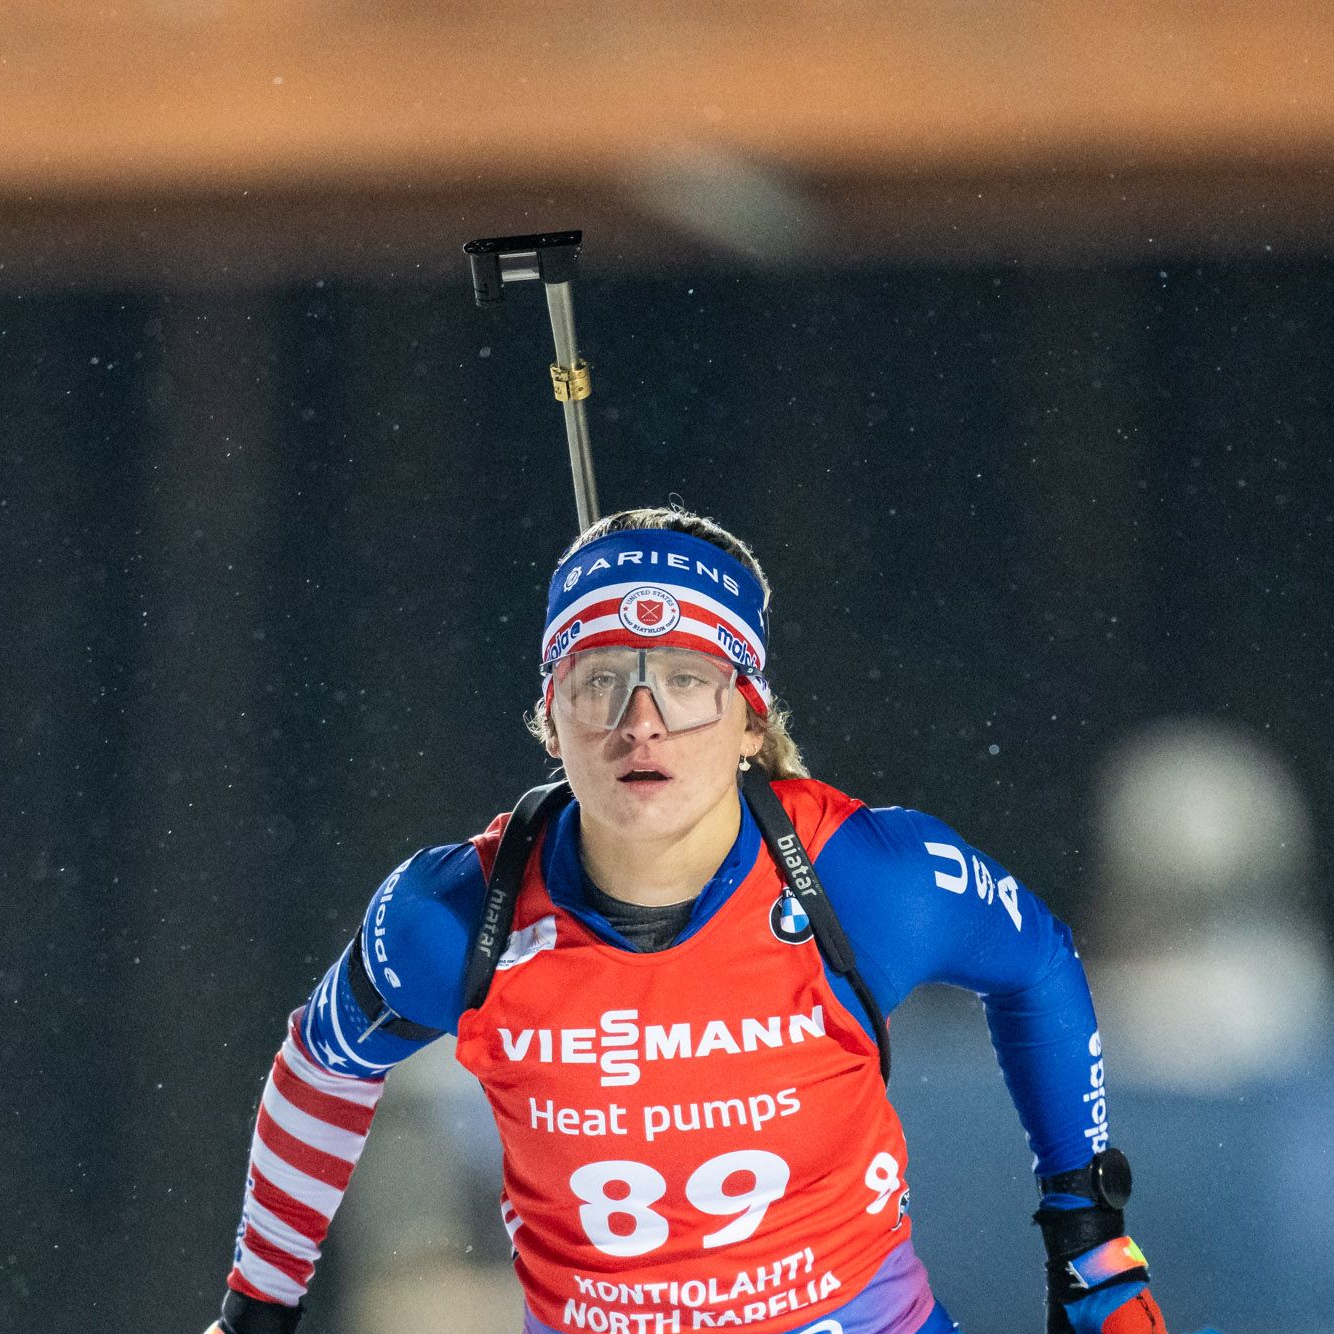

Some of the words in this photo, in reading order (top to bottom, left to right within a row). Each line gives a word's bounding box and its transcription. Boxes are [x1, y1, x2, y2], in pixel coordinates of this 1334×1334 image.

[586, 551, 740, 597] ARIENS
[627, 590, 651, 605] UNITED
[652, 590, 675, 607] STATES
[632, 624, 666, 634] BIATHLON
[777, 833, 818, 896] biatar
[923, 841, 1023, 933] USA
[497, 1004, 826, 1087] VIESSMANN
[529, 1097, 628, 1136] Heat
[643, 1087, 801, 1142] pumps
[1082, 1058, 1109, 1155] aloja
[569, 1149, 791, 1258] 89
[573, 1246, 815, 1308] KONTIOLAHTI
[692, 1270, 842, 1331] KARELIA
